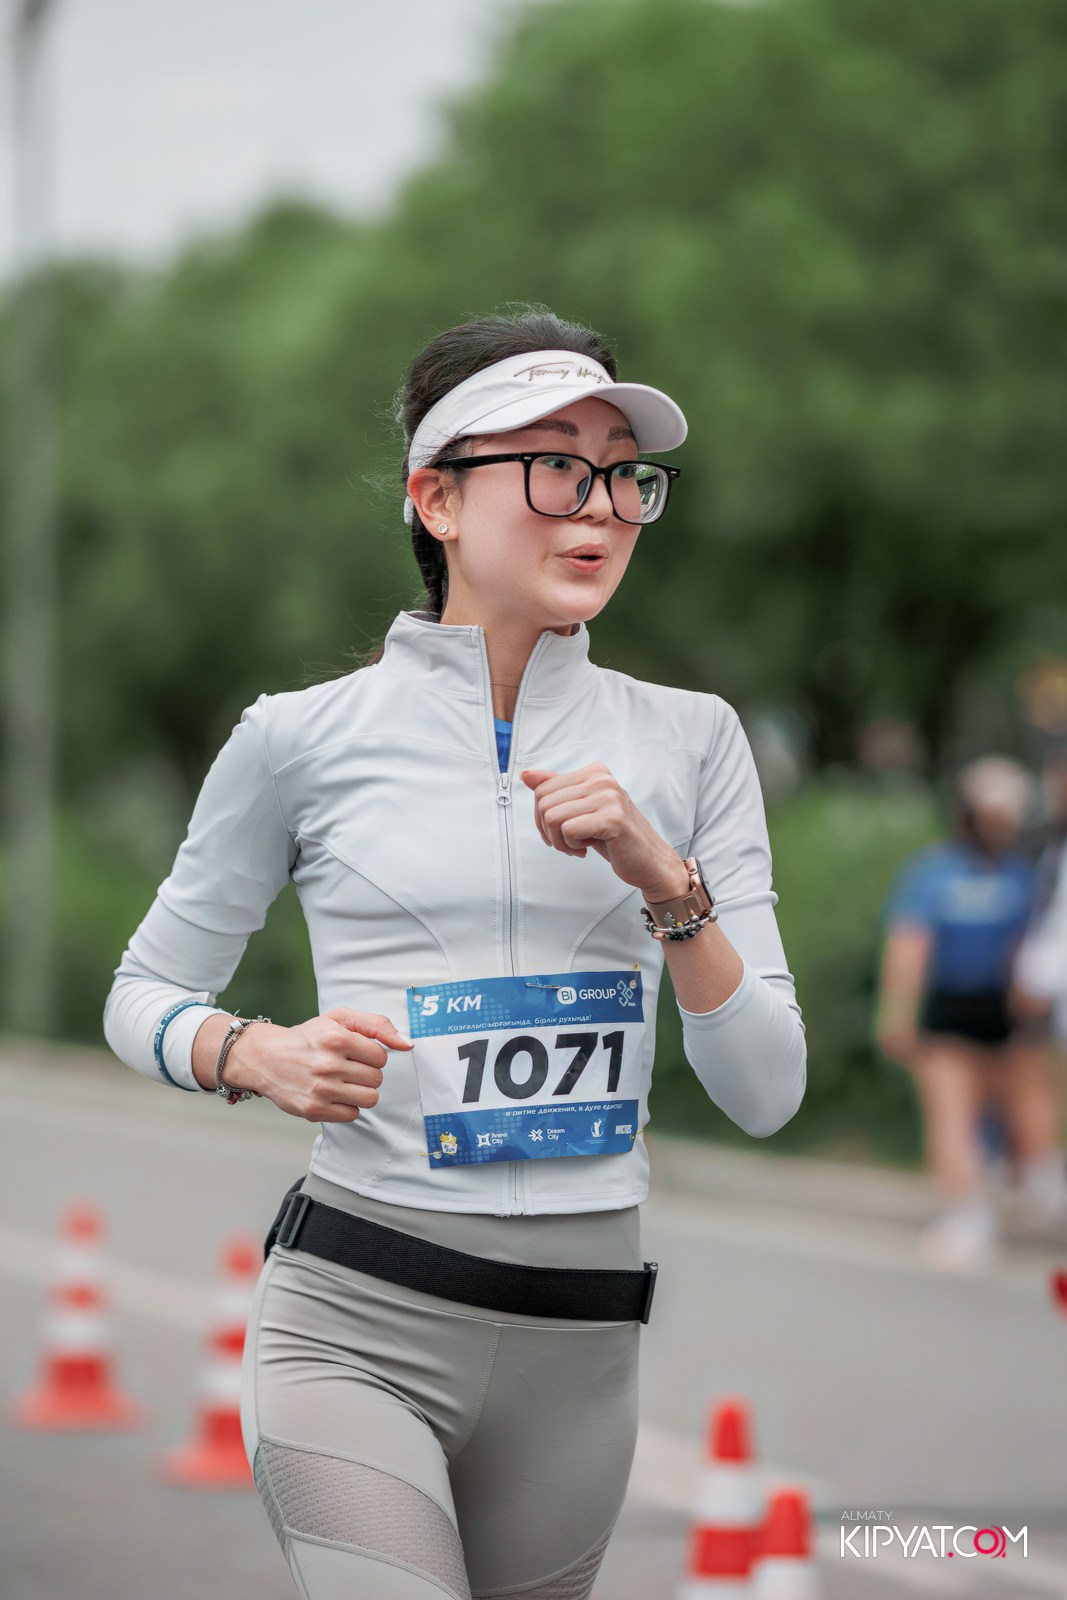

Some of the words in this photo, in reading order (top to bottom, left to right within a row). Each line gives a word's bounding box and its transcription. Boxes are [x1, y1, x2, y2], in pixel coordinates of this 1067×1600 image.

[579, 988, 617, 1000] GROUP
[421, 995, 440, 1016] 5
[457, 1030, 625, 1104] 1071
